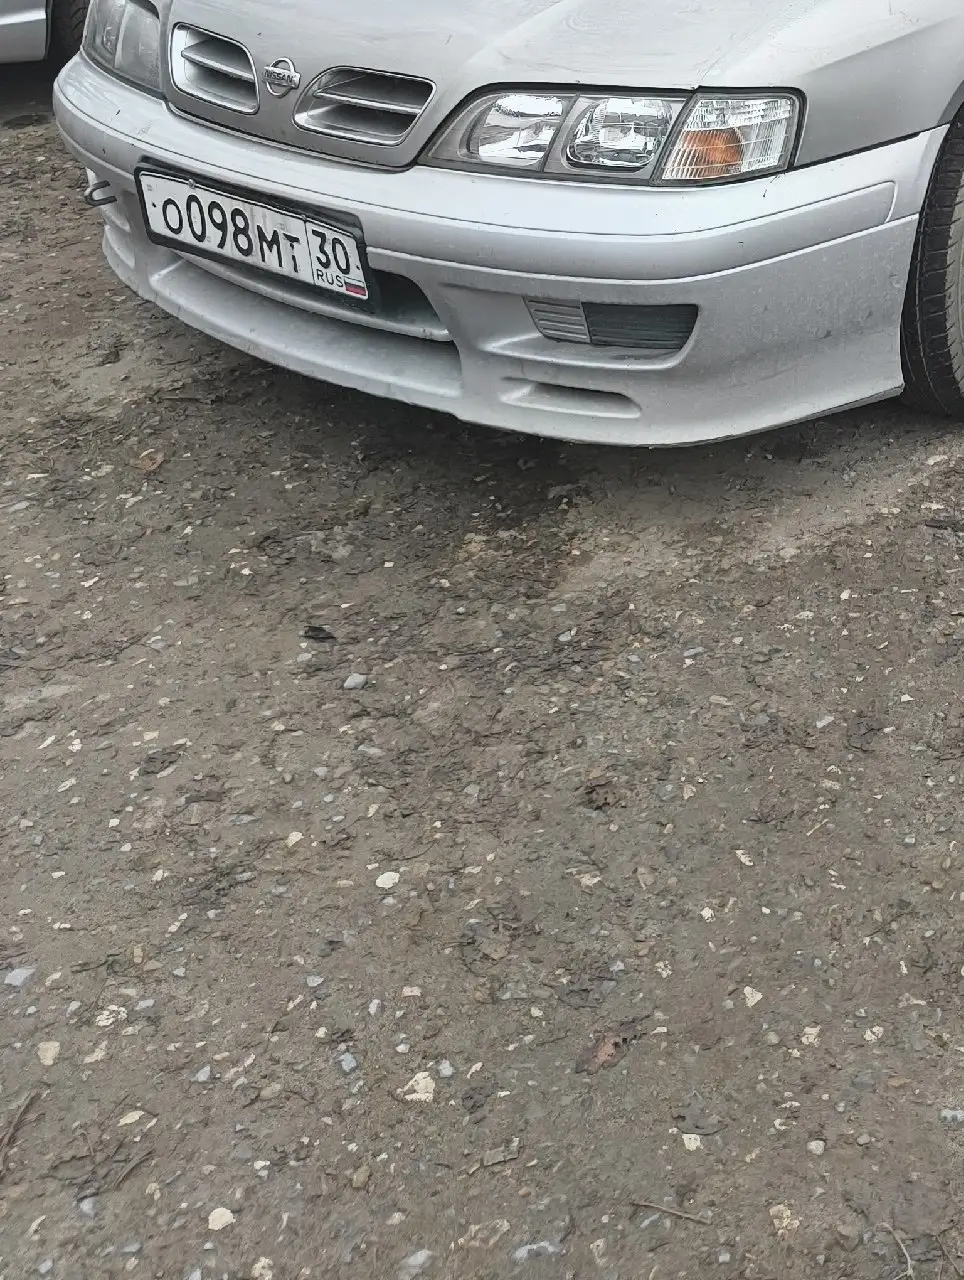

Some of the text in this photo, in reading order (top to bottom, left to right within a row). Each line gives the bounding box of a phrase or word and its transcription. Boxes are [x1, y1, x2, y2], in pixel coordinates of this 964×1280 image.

[264, 69, 295, 84] NISSAN
[312, 229, 350, 275] 30
[316, 268, 344, 288] RUS
